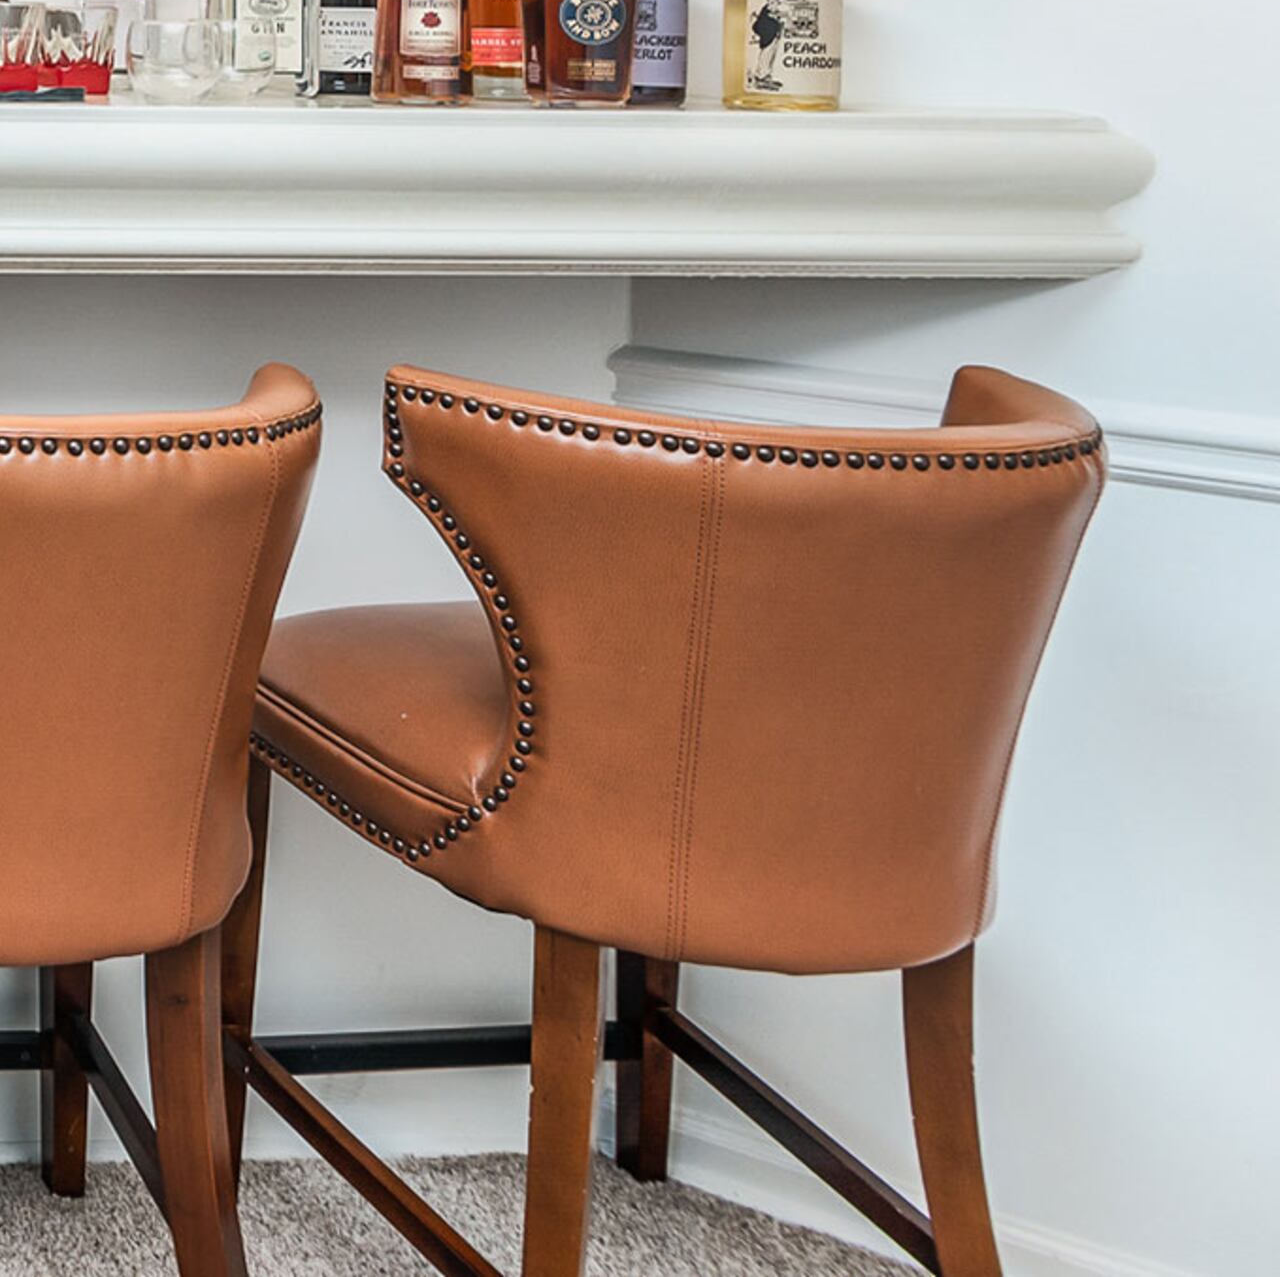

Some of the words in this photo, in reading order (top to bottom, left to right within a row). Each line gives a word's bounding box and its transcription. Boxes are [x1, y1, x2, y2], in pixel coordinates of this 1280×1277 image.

[250, 22, 285, 34] GIN
[566, 18, 591, 39] AND
[593, 19, 620, 40] BOW
[634, 48, 673, 60] ERLOT
[783, 41, 827, 54] PEACH
[782, 55, 842, 69] CHARDO
